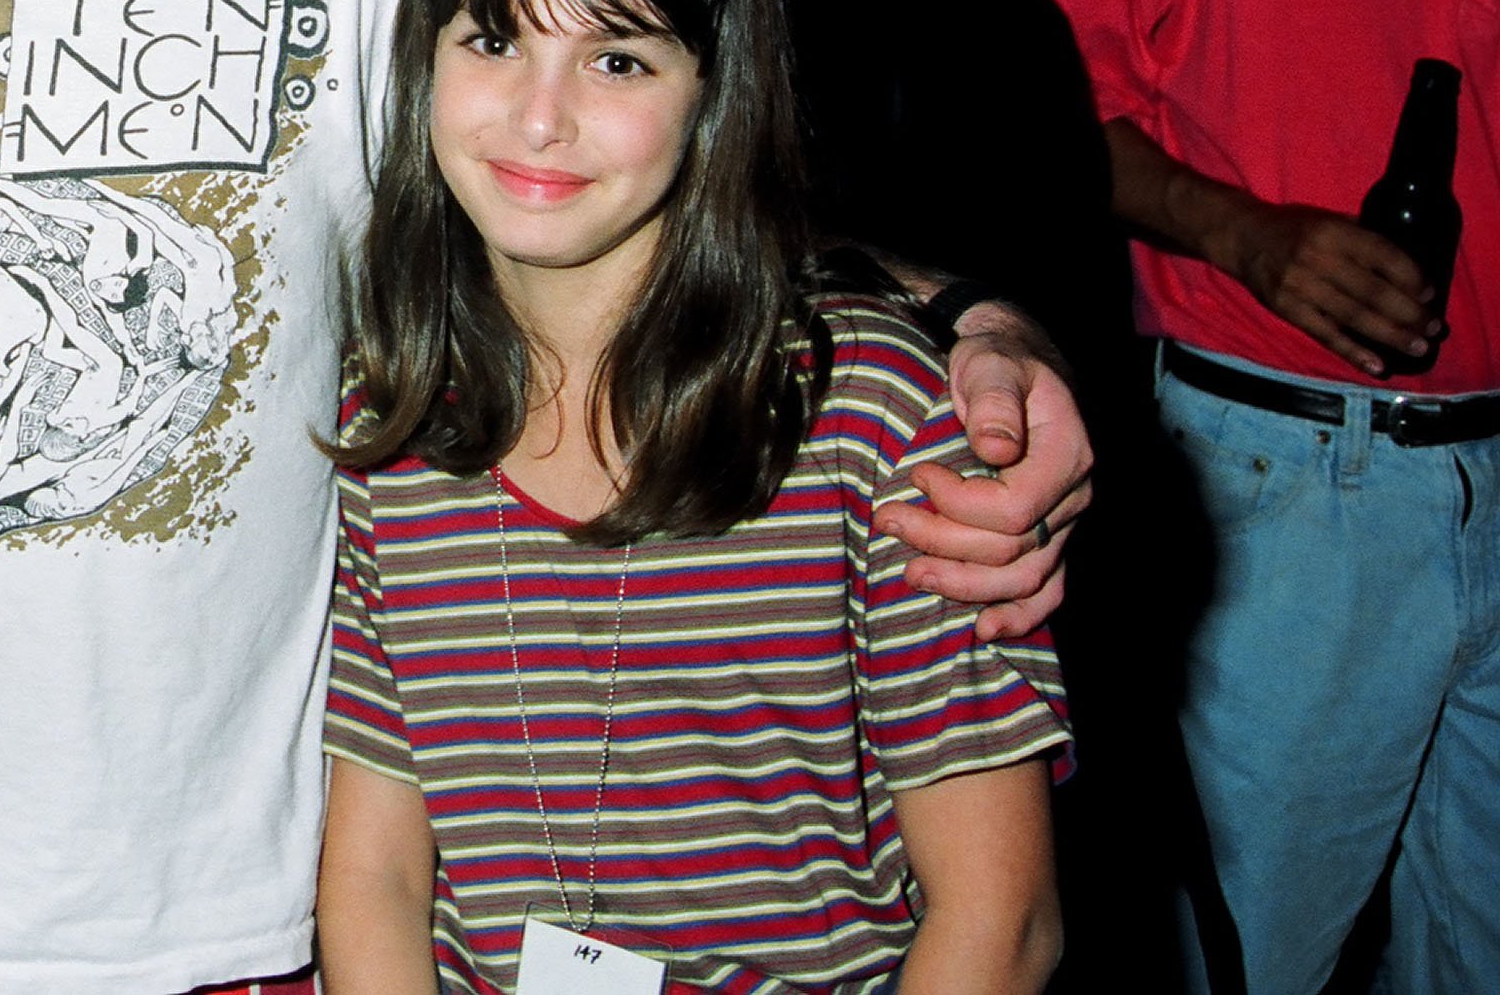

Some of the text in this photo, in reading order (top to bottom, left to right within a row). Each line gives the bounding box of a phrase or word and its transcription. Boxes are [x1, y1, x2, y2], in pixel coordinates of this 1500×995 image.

[22, 33, 267, 102] INCH
[9, 94, 261, 162] MEN
[574, 944, 602, 964] 147
